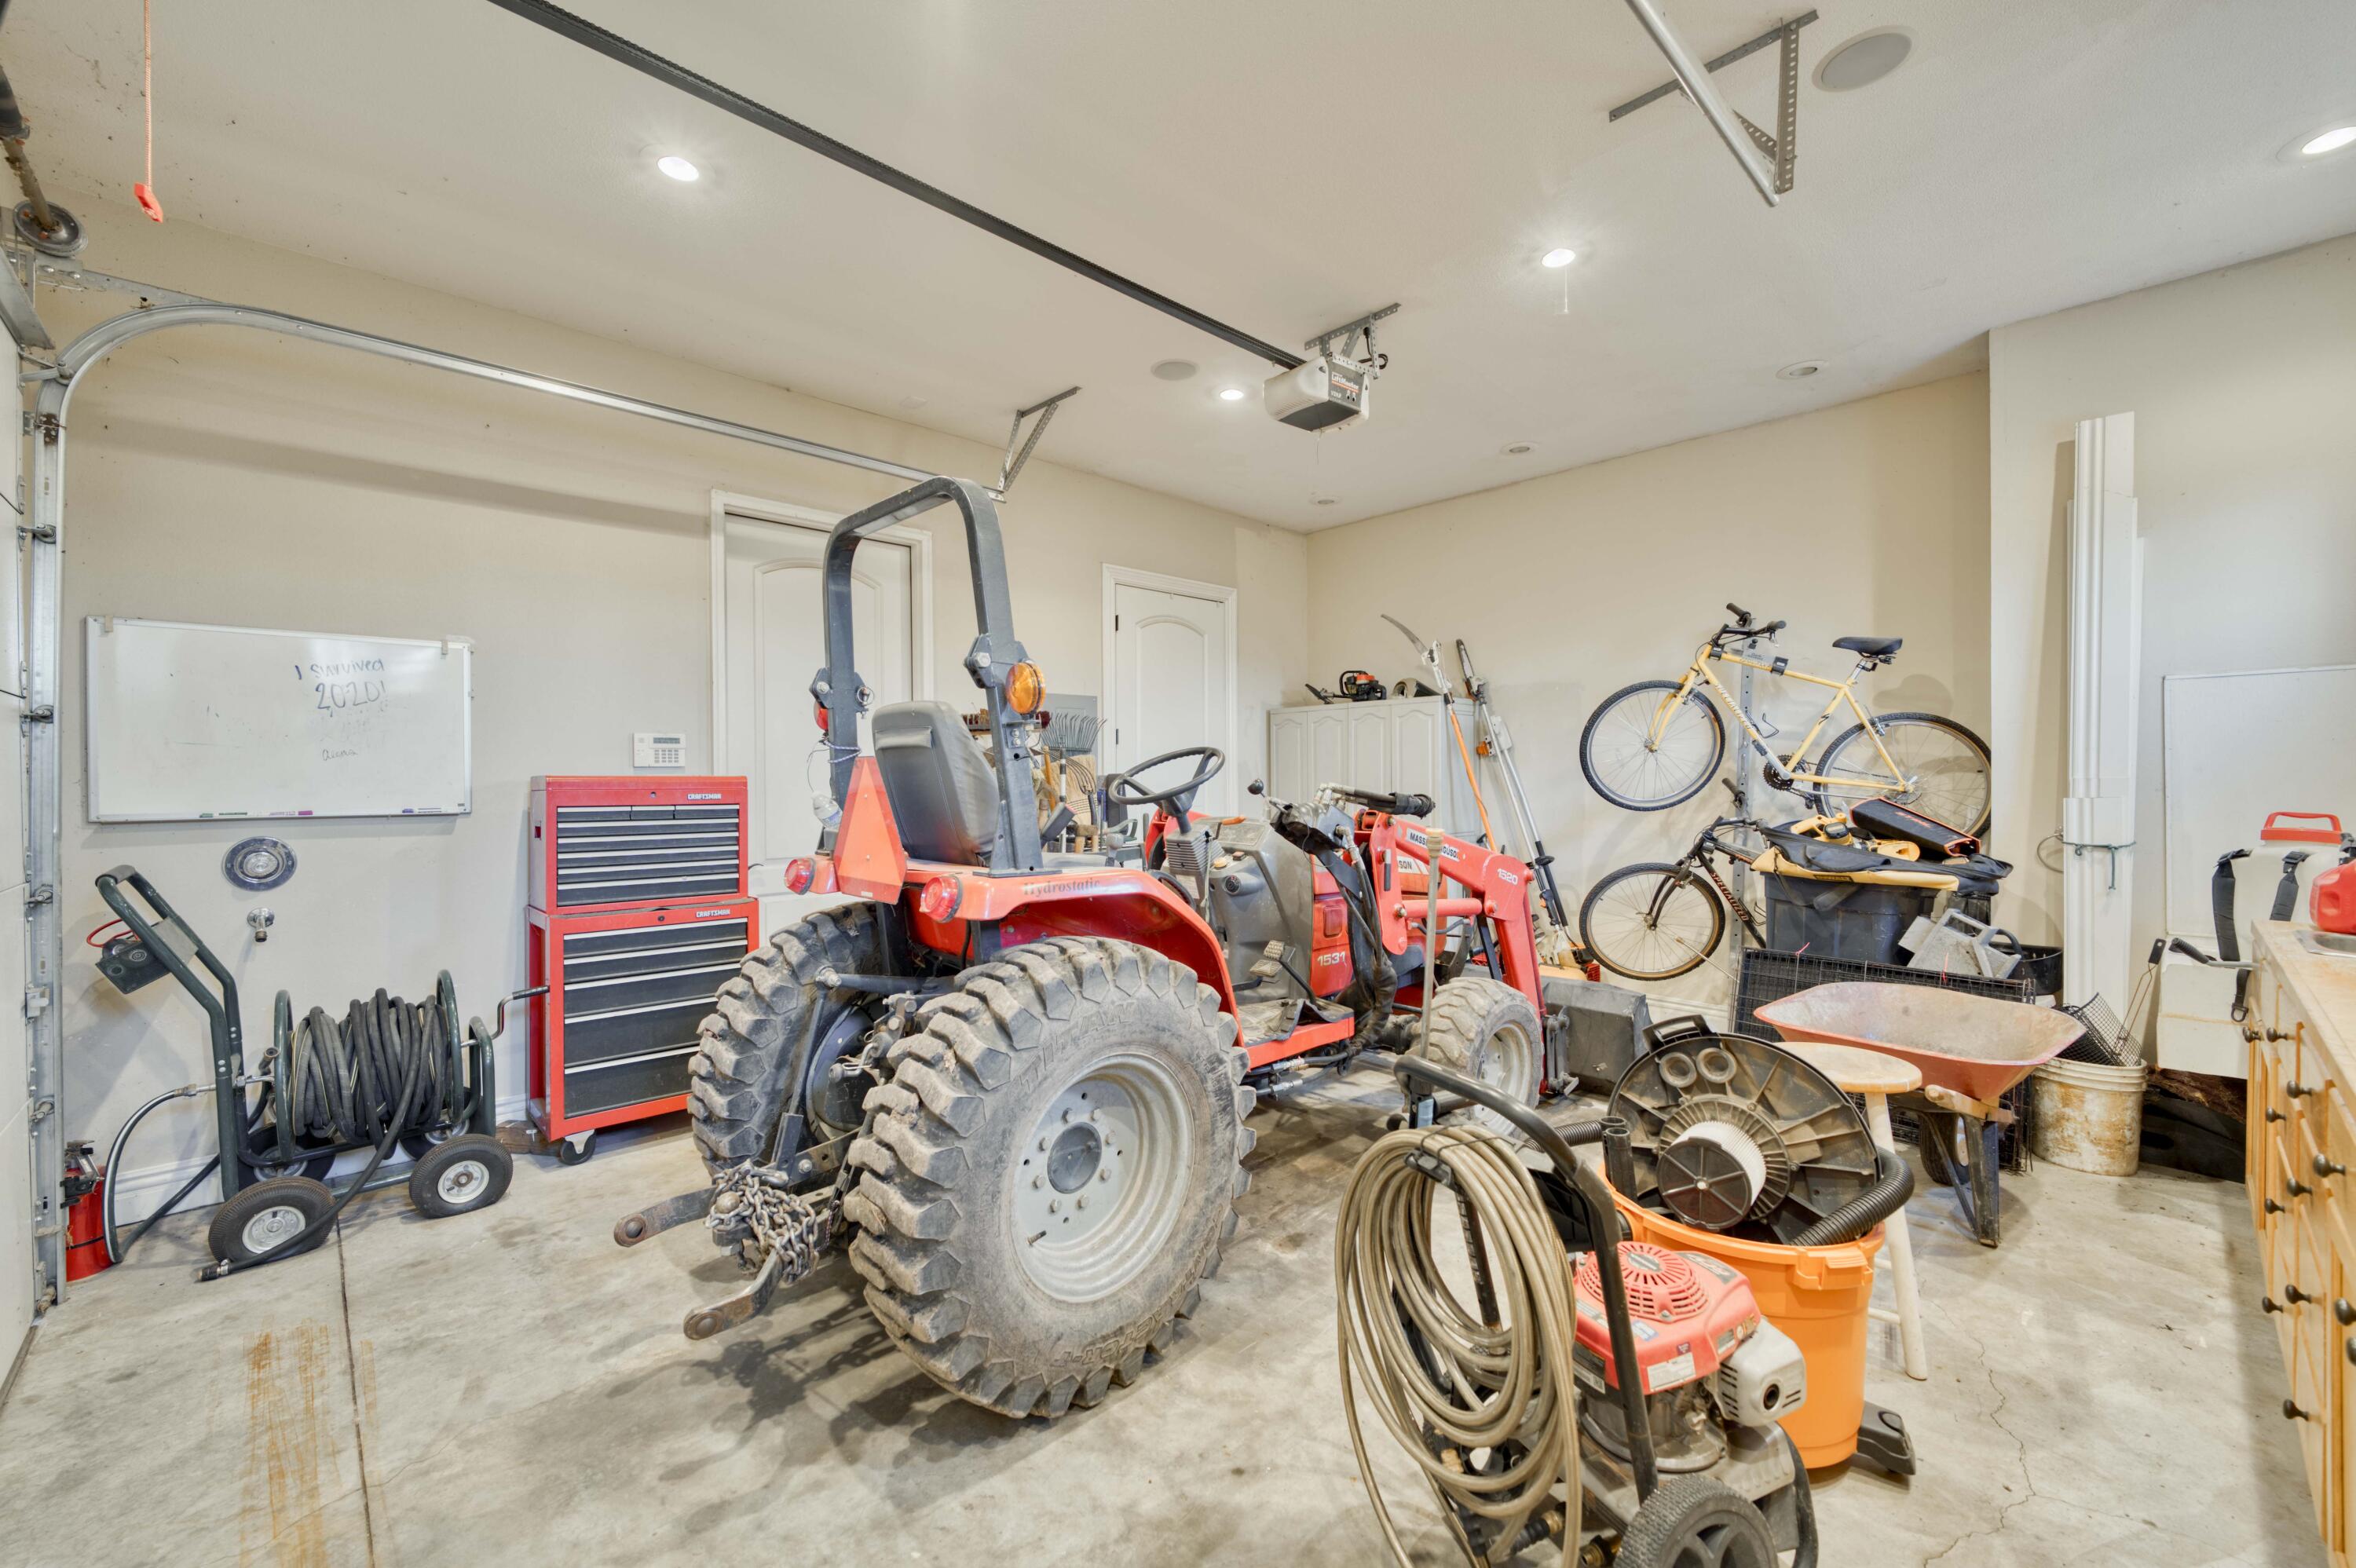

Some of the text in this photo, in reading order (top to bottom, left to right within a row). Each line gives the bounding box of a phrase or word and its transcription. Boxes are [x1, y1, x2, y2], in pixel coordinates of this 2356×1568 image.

[1410, 832, 1427, 846] MASS
[1498, 868, 1518, 886] 1520
[1023, 878, 1100, 897] Hydrostatic
[1710, 872, 1750, 922] SPECIALIZED
[1317, 951, 1346, 967] 1531
